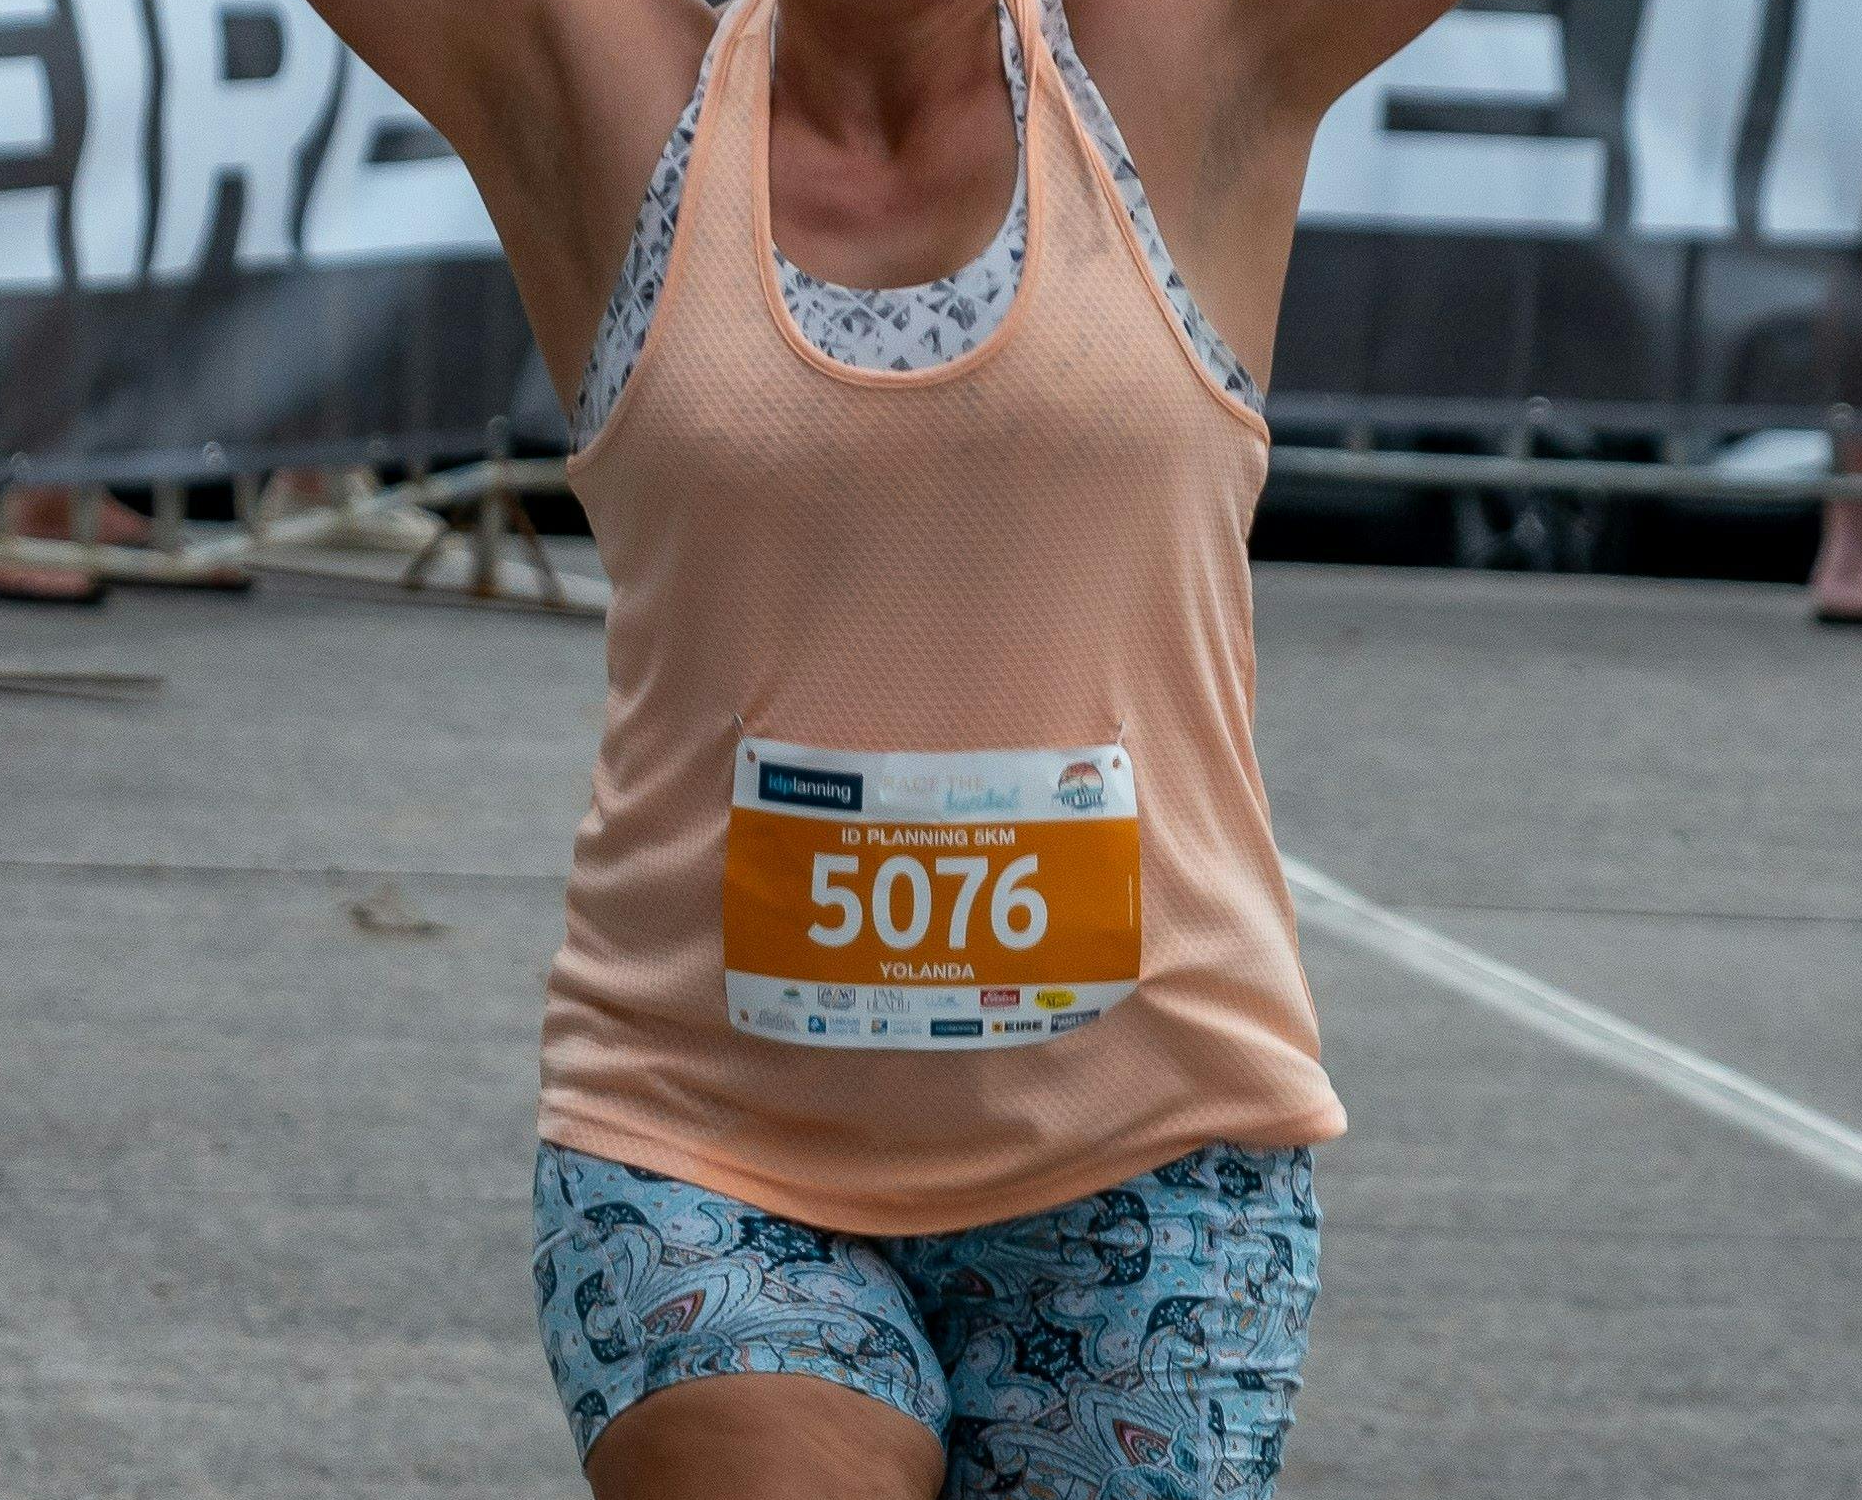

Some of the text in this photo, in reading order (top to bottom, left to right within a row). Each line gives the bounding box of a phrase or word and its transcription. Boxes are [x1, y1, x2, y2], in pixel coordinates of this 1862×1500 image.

[841, 826, 861, 846] ID
[866, 827, 969, 848] PLANNING
[807, 851, 1048, 951] 5076
[879, 960, 976, 981] YOLANDA
